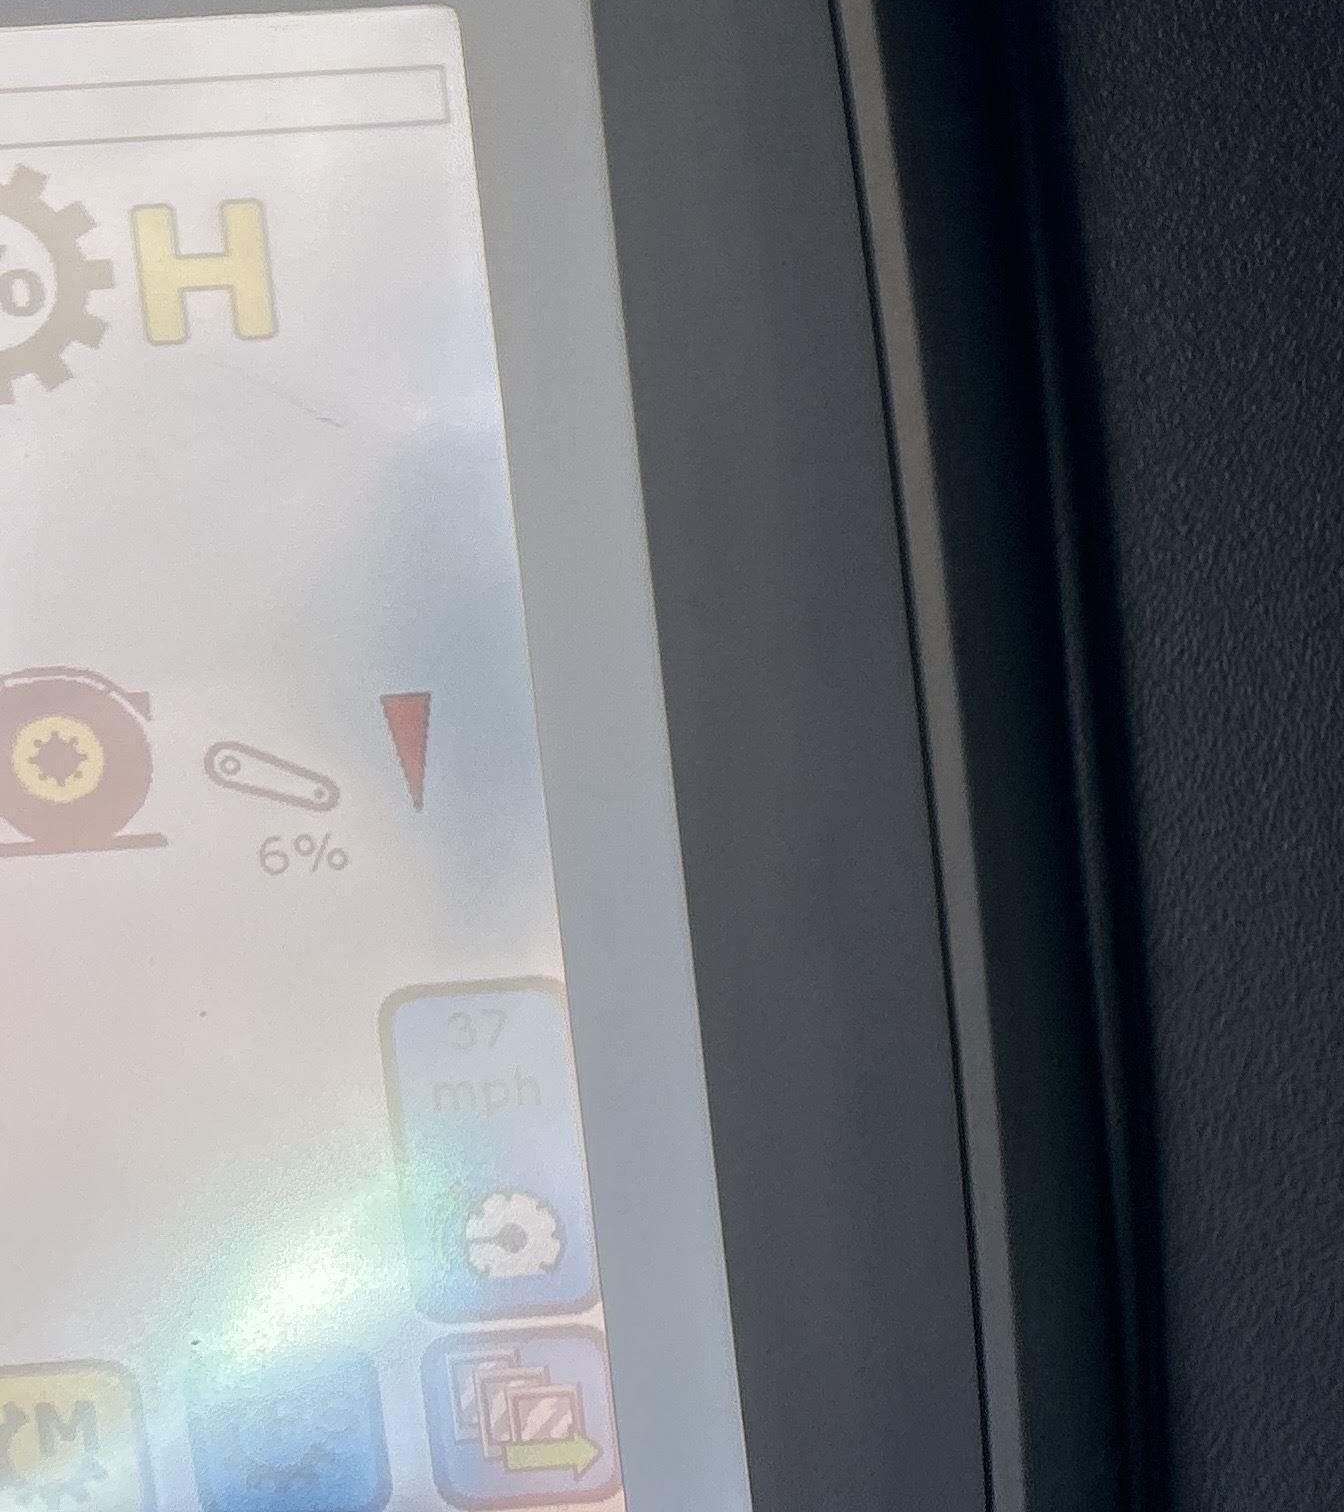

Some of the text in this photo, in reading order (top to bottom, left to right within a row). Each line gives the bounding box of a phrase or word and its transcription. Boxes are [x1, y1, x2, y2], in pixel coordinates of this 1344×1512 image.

[130, 198, 279, 345] H
[257, 832, 350, 876] 6%
[447, 1008, 509, 1050] 37
[432, 1066, 543, 1118] mph
